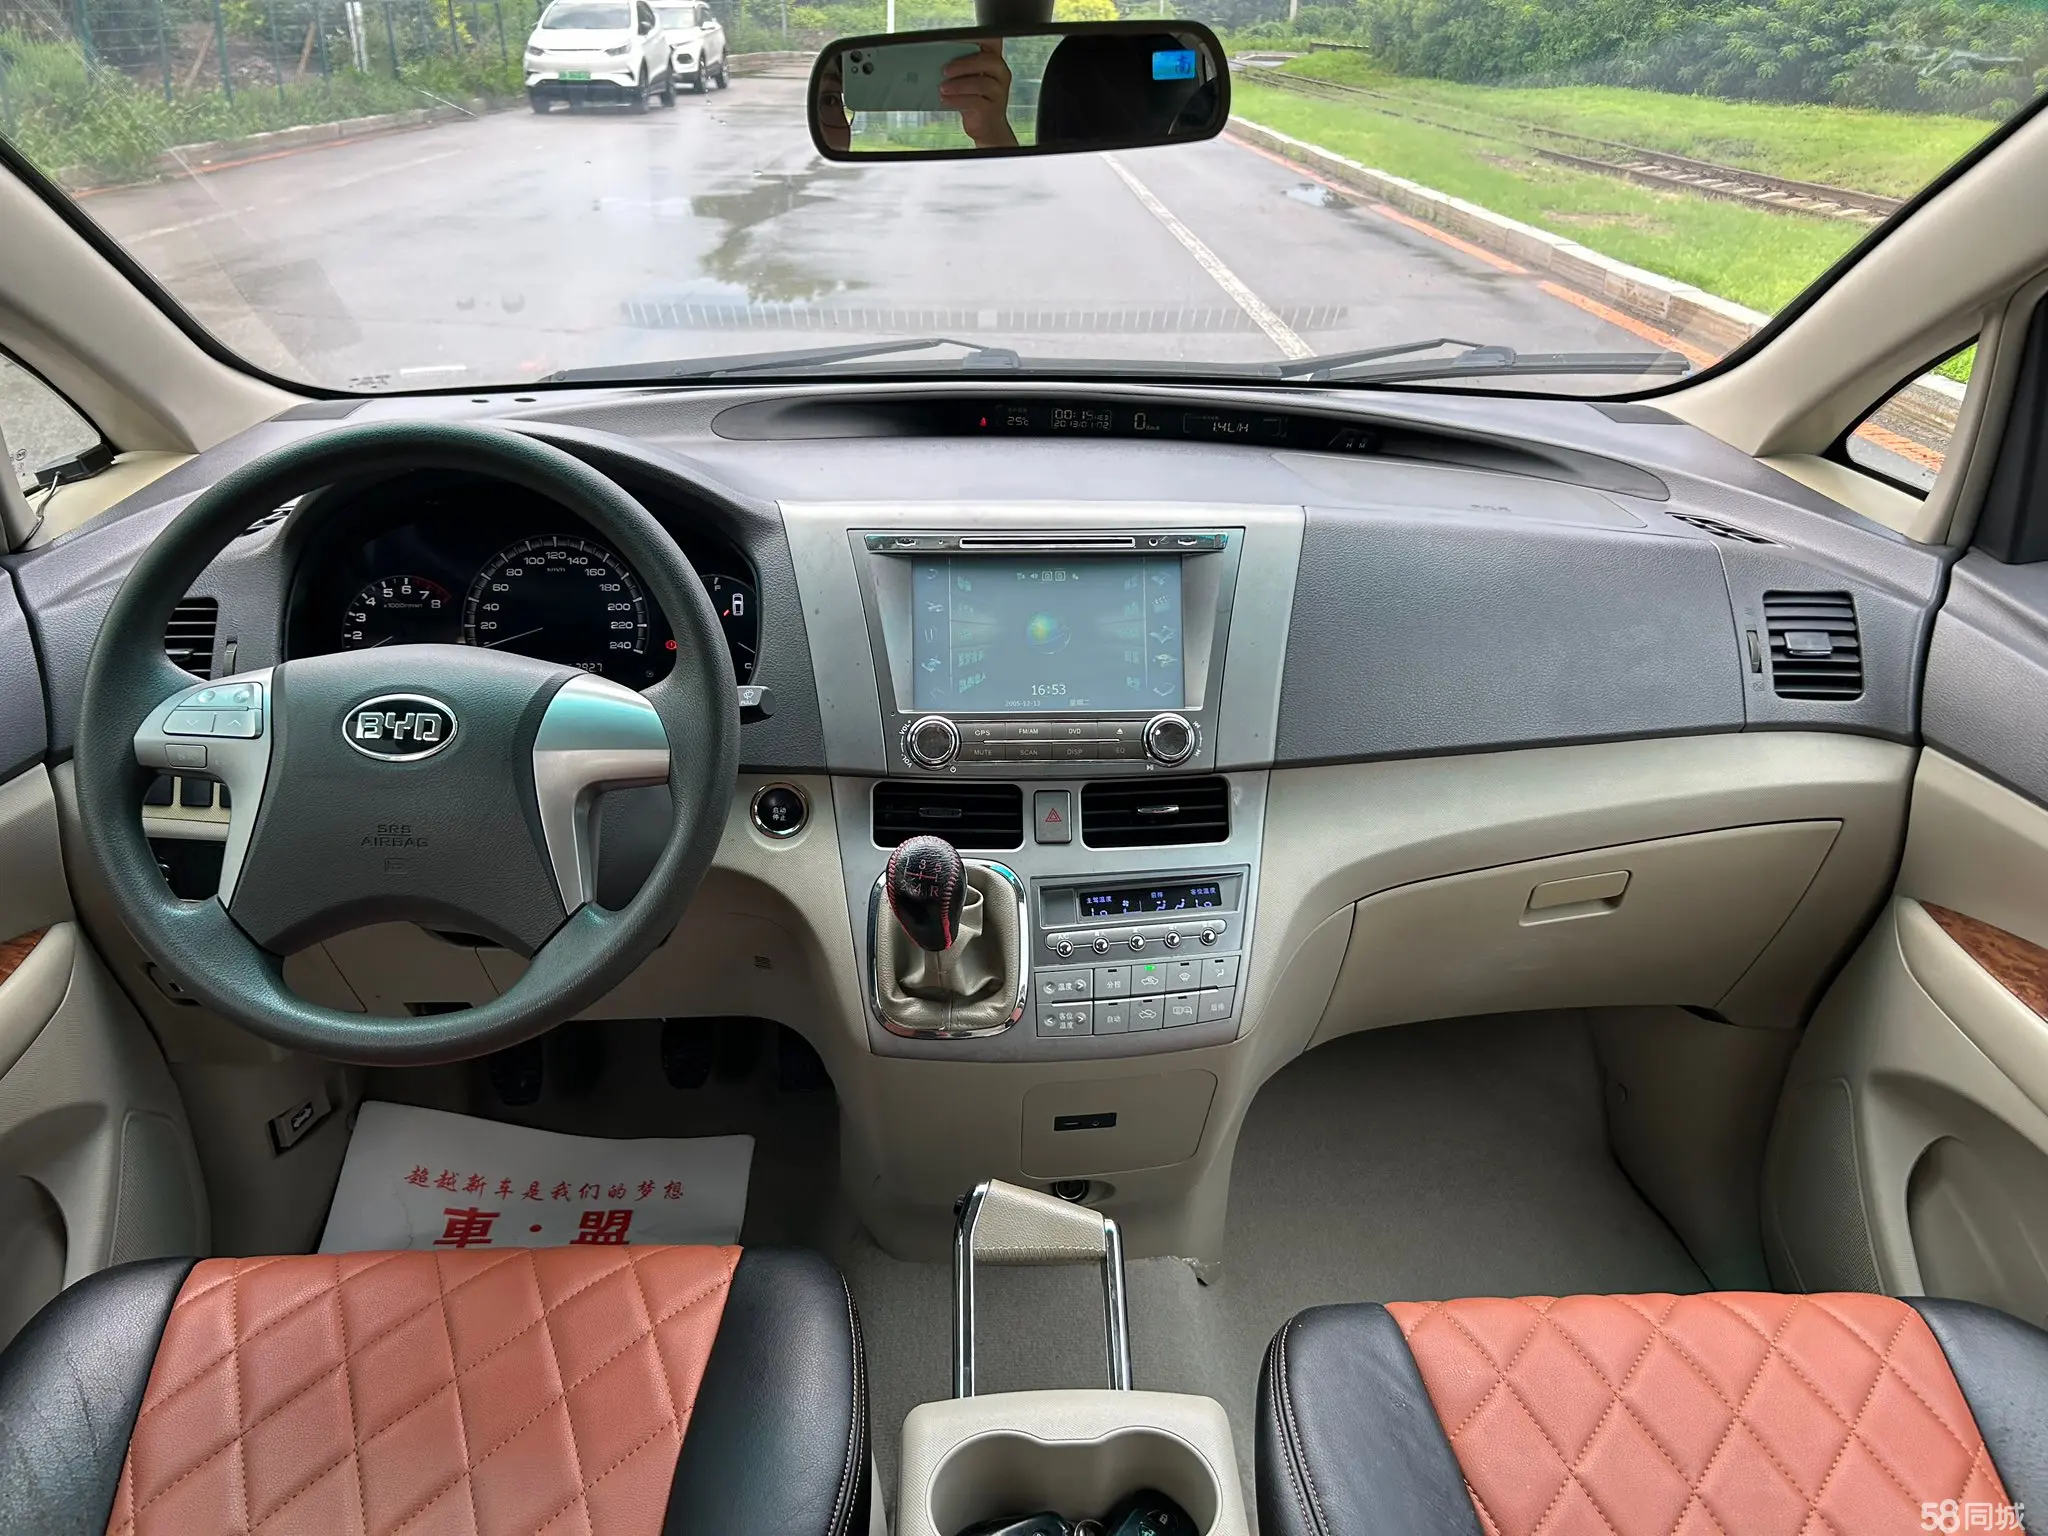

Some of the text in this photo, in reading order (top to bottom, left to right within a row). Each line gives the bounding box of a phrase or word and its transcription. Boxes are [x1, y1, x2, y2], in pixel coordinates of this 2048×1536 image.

[546, 551, 567, 560] 120
[523, 556, 545, 565] 100
[567, 556, 588, 565] 140
[506, 568, 523, 577] 80
[584, 568, 606, 577] 160
[401, 585, 412, 595] 6
[492, 583, 509, 592] 60
[599, 583, 621, 592] 180
[383, 588, 394, 598] 5
[419, 590, 430, 600] 7
[365, 596, 376, 606] 4
[431, 599, 441, 609] 8
[482, 603, 499, 611] 40
[607, 603, 631, 611] 200
[355, 612, 367, 622] 3
[480, 621, 497, 630] 20
[610, 621, 634, 630] 220
[352, 630, 362, 640] 2
[609, 641, 632, 650] 240
[1031, 684, 1066, 696] 16:53
[355, 711, 442, 741] BYD
[1066, 748, 1083, 756] DISP
[1115, 747, 1125, 755] EQ
[376, 824, 412, 834] SRS
[360, 836, 429, 847] AIRBAG
[919, 859, 927, 870] 3
[935, 862, 942, 873] 5
[931, 885, 939, 897] R
[1058, 982, 1073, 991] 温度
[1106, 1015, 1121, 1024] 自动
[1059, 1021, 1074, 1030] 温度
[404, 1164, 685, 1202] 超越新车是我们的梦想
